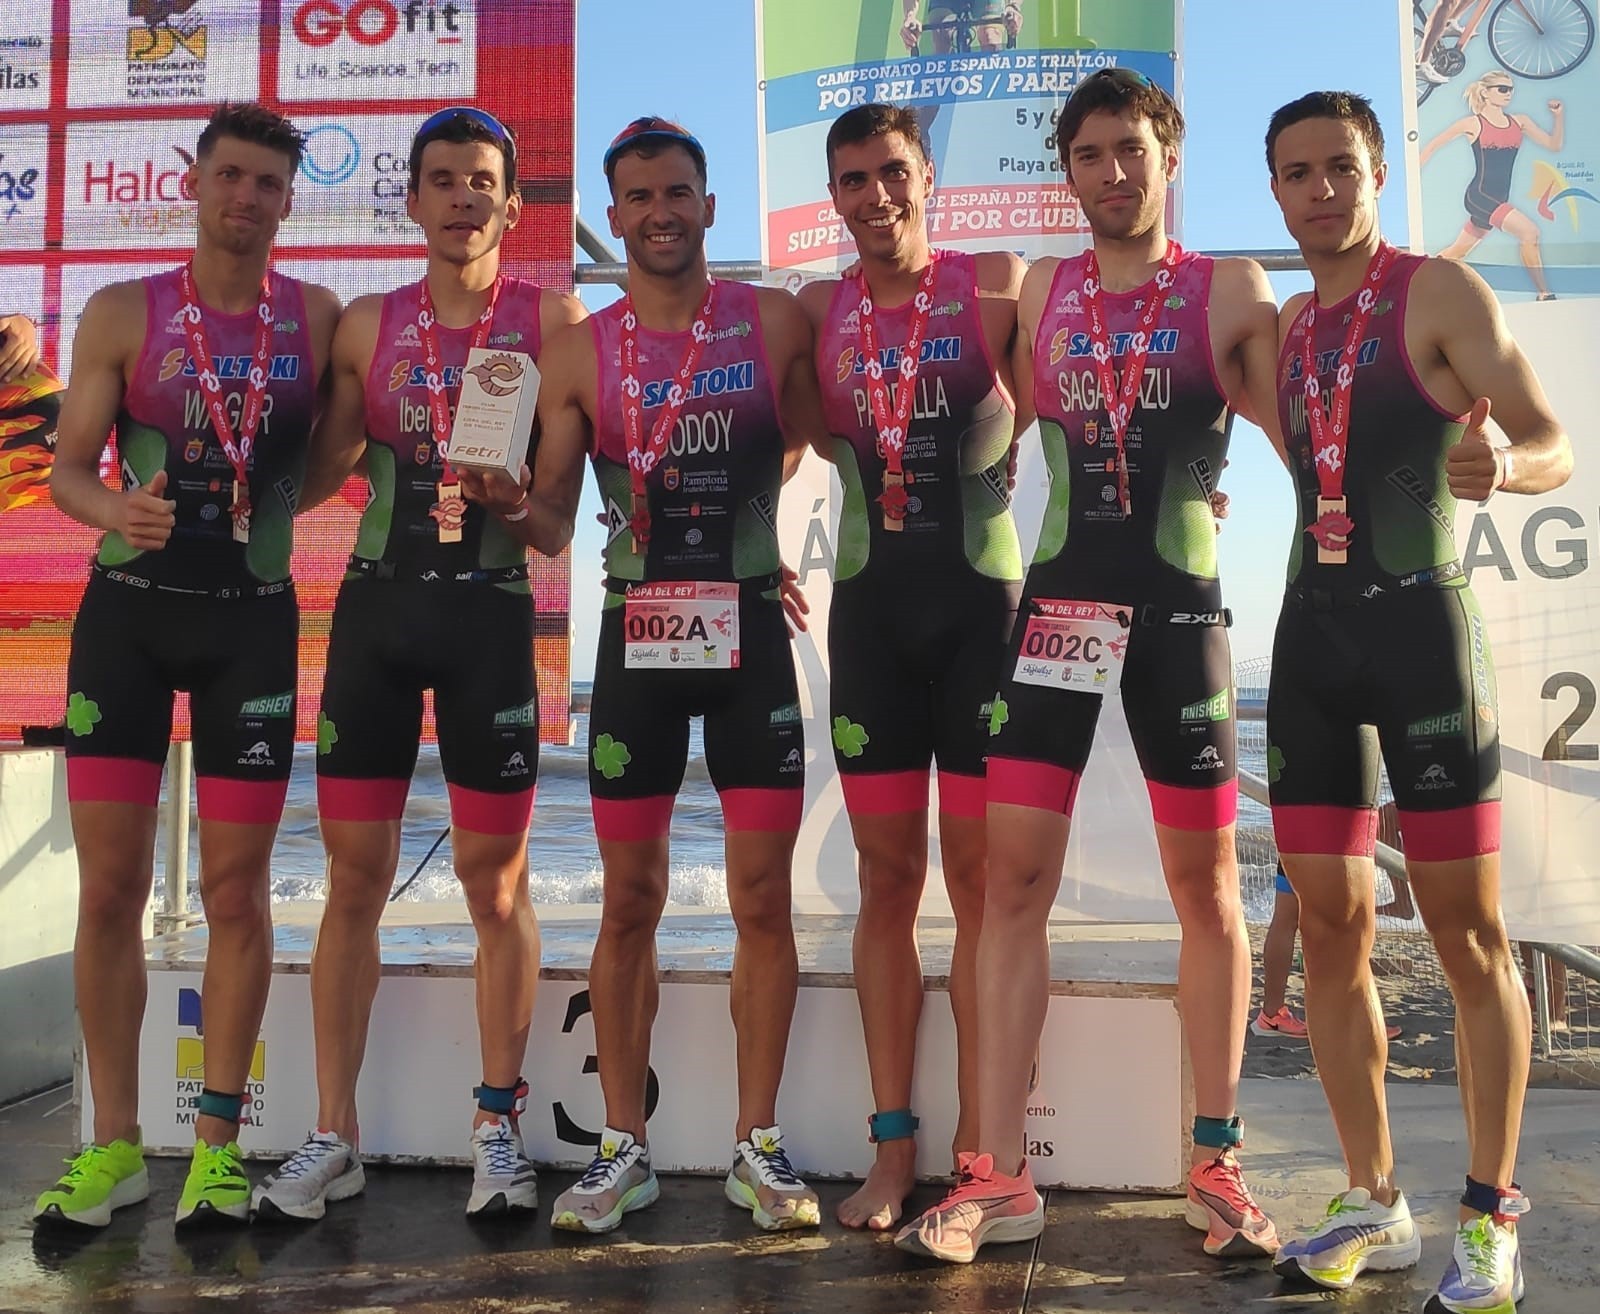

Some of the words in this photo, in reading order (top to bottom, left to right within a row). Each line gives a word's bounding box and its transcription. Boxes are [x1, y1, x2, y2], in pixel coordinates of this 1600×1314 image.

[127, 62, 206, 72] PATRONATO
[816, 62, 921, 88] CAMPEONATO
[925, 60, 946, 75] DE
[950, 54, 1011, 71] ESPAÑA
[1015, 55, 1036, 69] DE
[1041, 52, 1118, 68] TRIATLÓN
[127, 75, 206, 85] DEPORTIVO
[127, 88, 204, 98] MUNICIPAL
[818, 86, 867, 111] POR
[873, 73, 983, 102] RELEVOS
[1016, 108, 1028, 126] 5
[1032, 112, 1044, 129] y
[999, 157, 1045, 175] Playa
[1050, 159, 1068, 173] de
[926, 195, 946, 209] DE
[950, 189, 1011, 207] ESPAÑA
[1015, 191, 1036, 204] DE
[1041, 190, 1079, 204] TRIA
[950, 209, 1002, 231] POR
[642, 360, 755, 409] SATOKI
[904, 441, 937, 454] mplona
[683, 476, 728, 487] Pamplona
[655, 587, 672, 597] DEL
[675, 586, 693, 596] REY
[1038, 603, 1055, 614] OPA
[1056, 604, 1074, 615] DEL
[1075, 606, 1094, 616] REY
[629, 614, 709, 641] 002A
[1026, 631, 1103, 663] 002C
[1472, 615, 1490, 703] SALTOKI
[1182, 695, 1227, 720] FINISHER
[1408, 712, 1462, 737] FINISHER
[176, 1081, 265, 1095] PATTO
